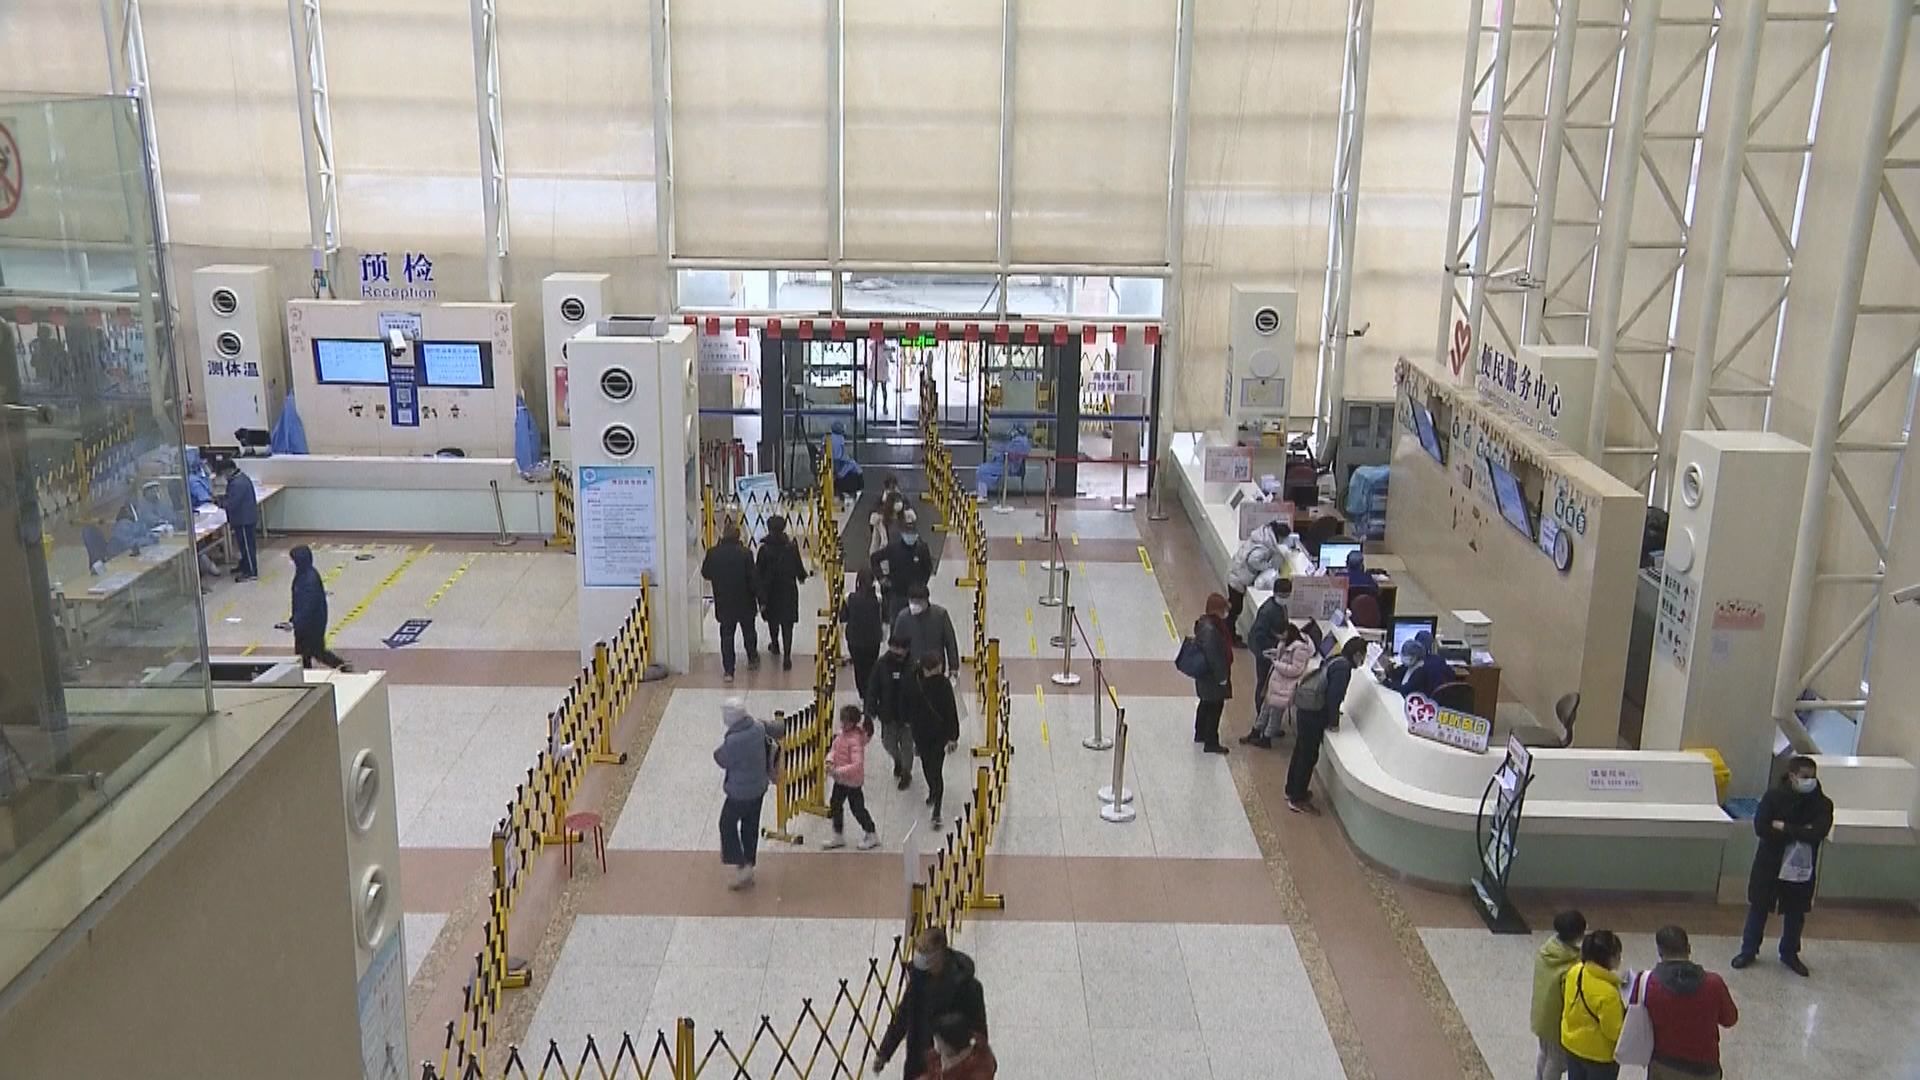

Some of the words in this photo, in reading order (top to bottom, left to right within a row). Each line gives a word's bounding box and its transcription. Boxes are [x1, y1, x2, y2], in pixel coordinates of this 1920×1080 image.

[361, 252, 433, 282] 预检
[362, 286, 437, 299] Reception
[207, 360, 259, 377] 测体温
[1481, 342, 1561, 417] 便民服务中心
